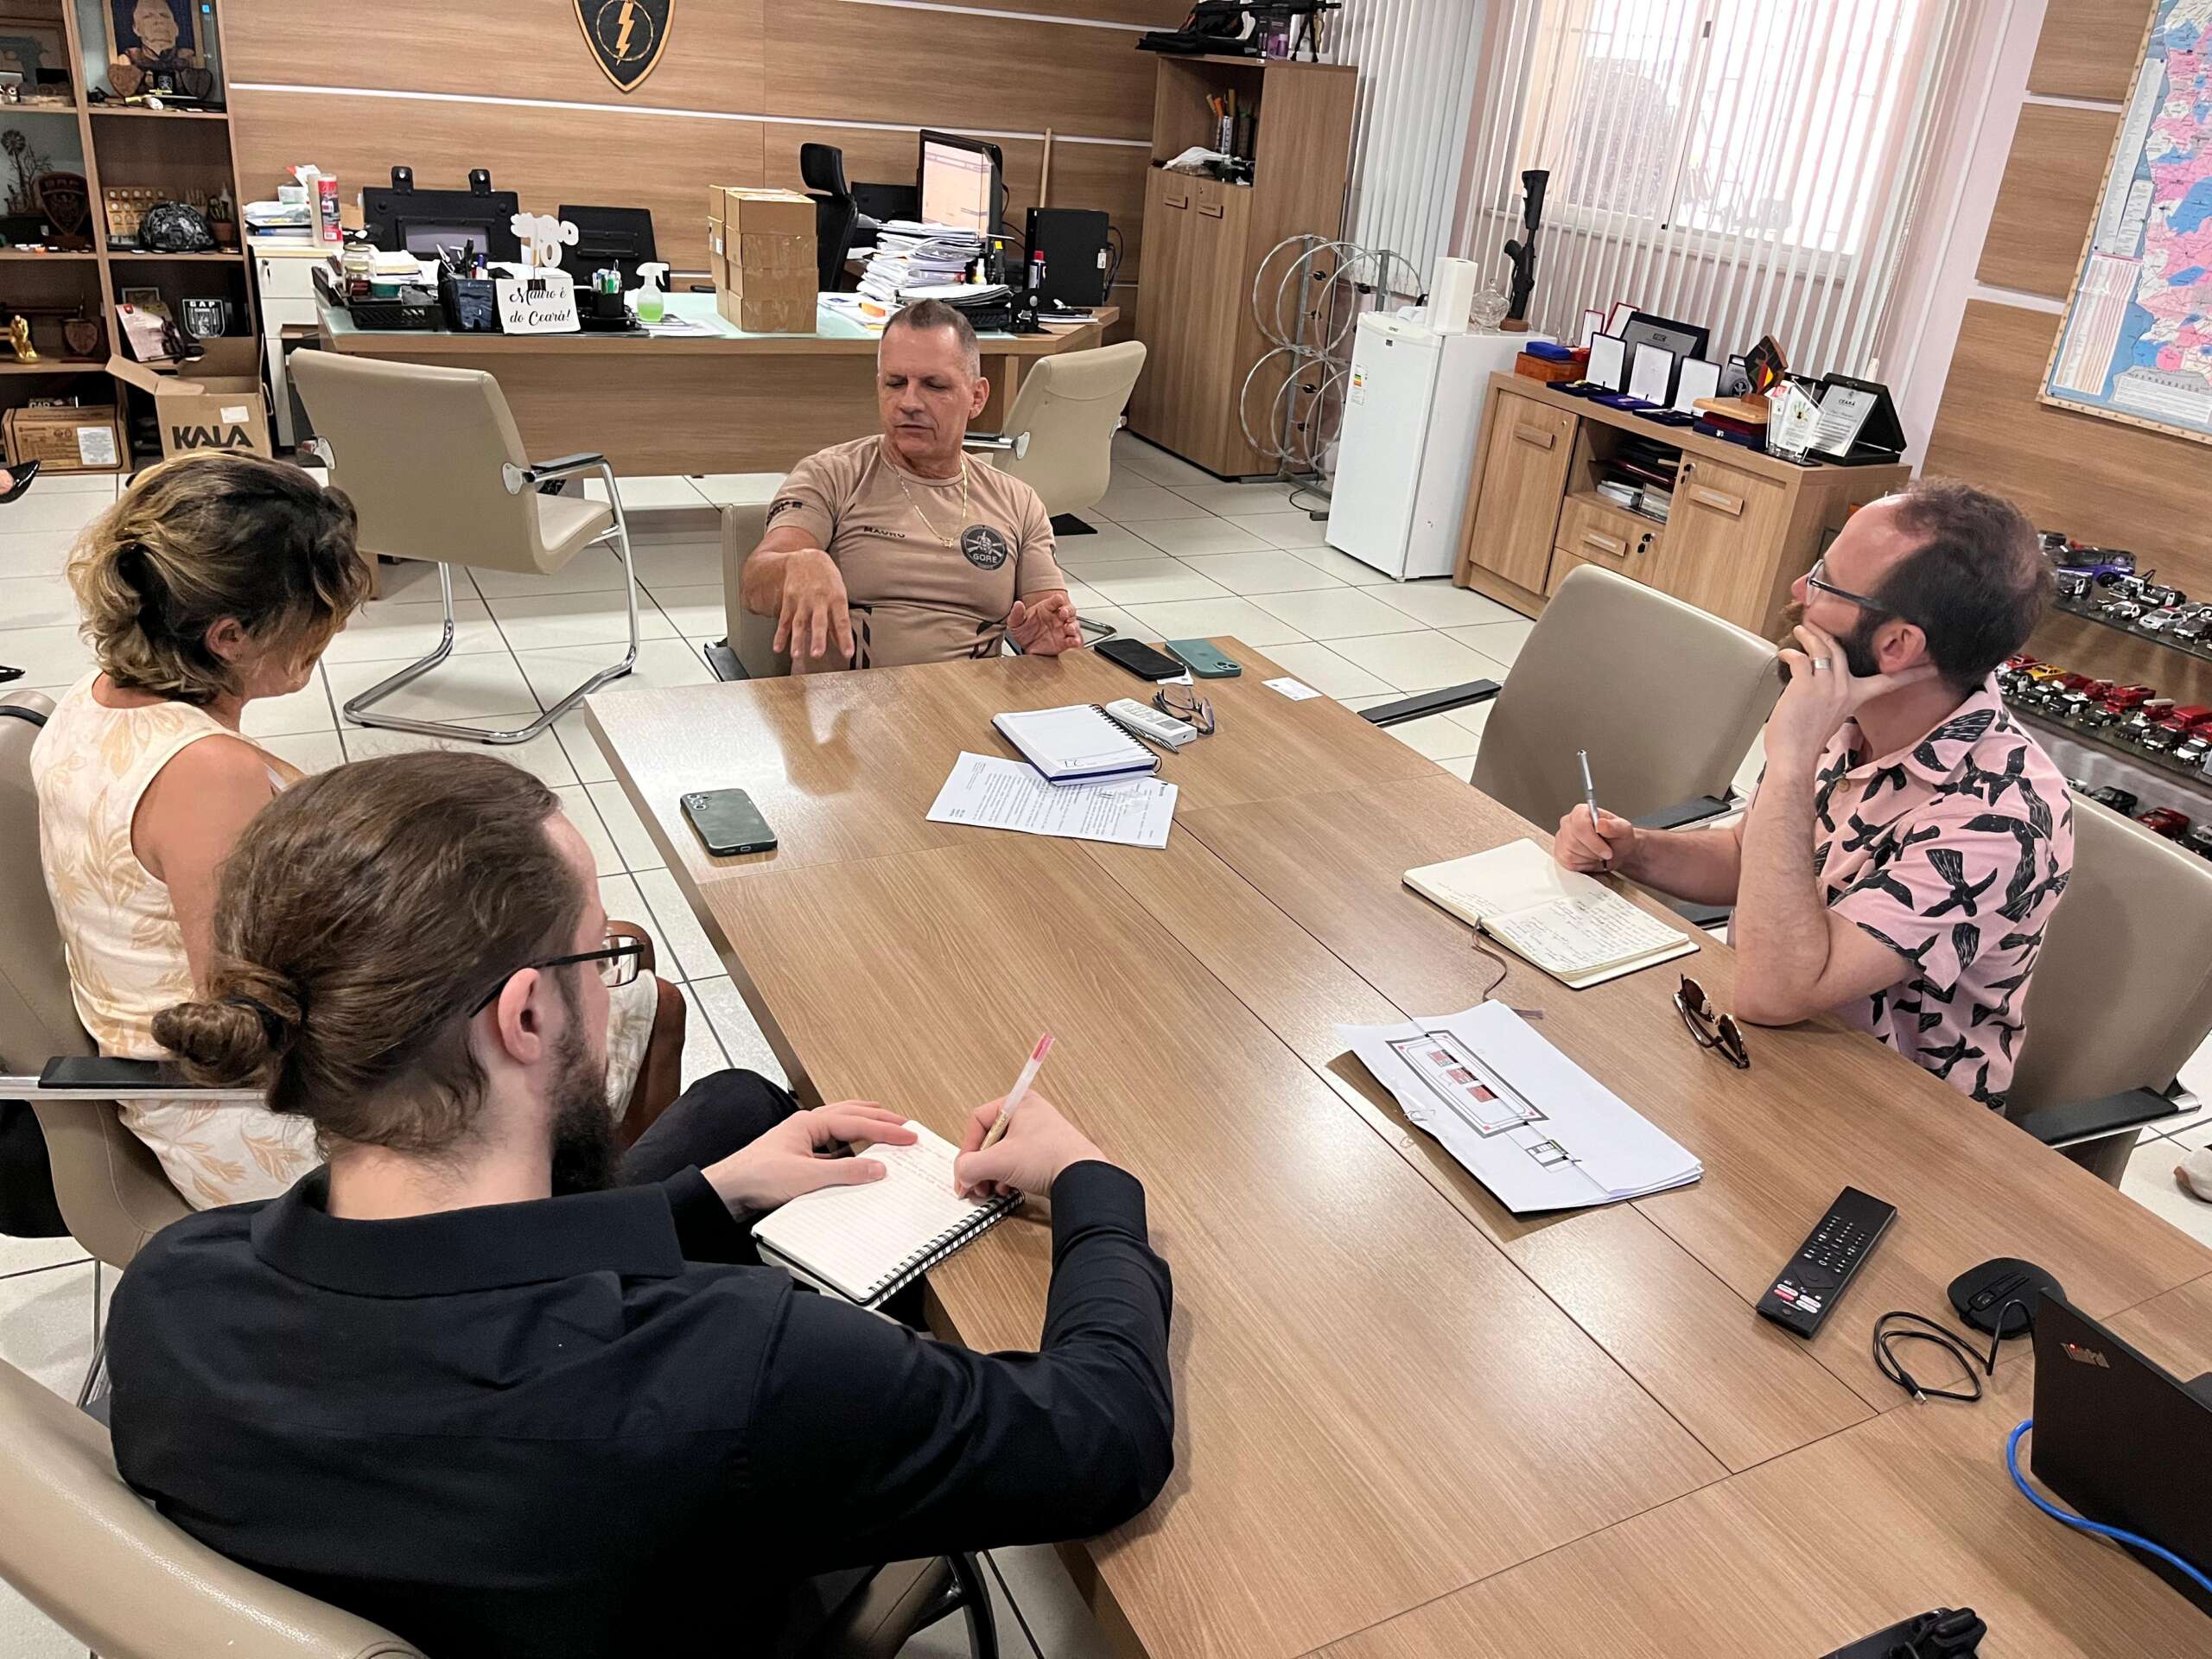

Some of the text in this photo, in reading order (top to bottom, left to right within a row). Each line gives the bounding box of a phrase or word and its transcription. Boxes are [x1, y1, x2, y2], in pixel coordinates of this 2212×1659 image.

[509, 287, 556, 306] Mauro
[510, 309, 570, 327] do Ceará!
[172, 425, 254, 449] KALA
[973, 553, 998, 563] GORE
